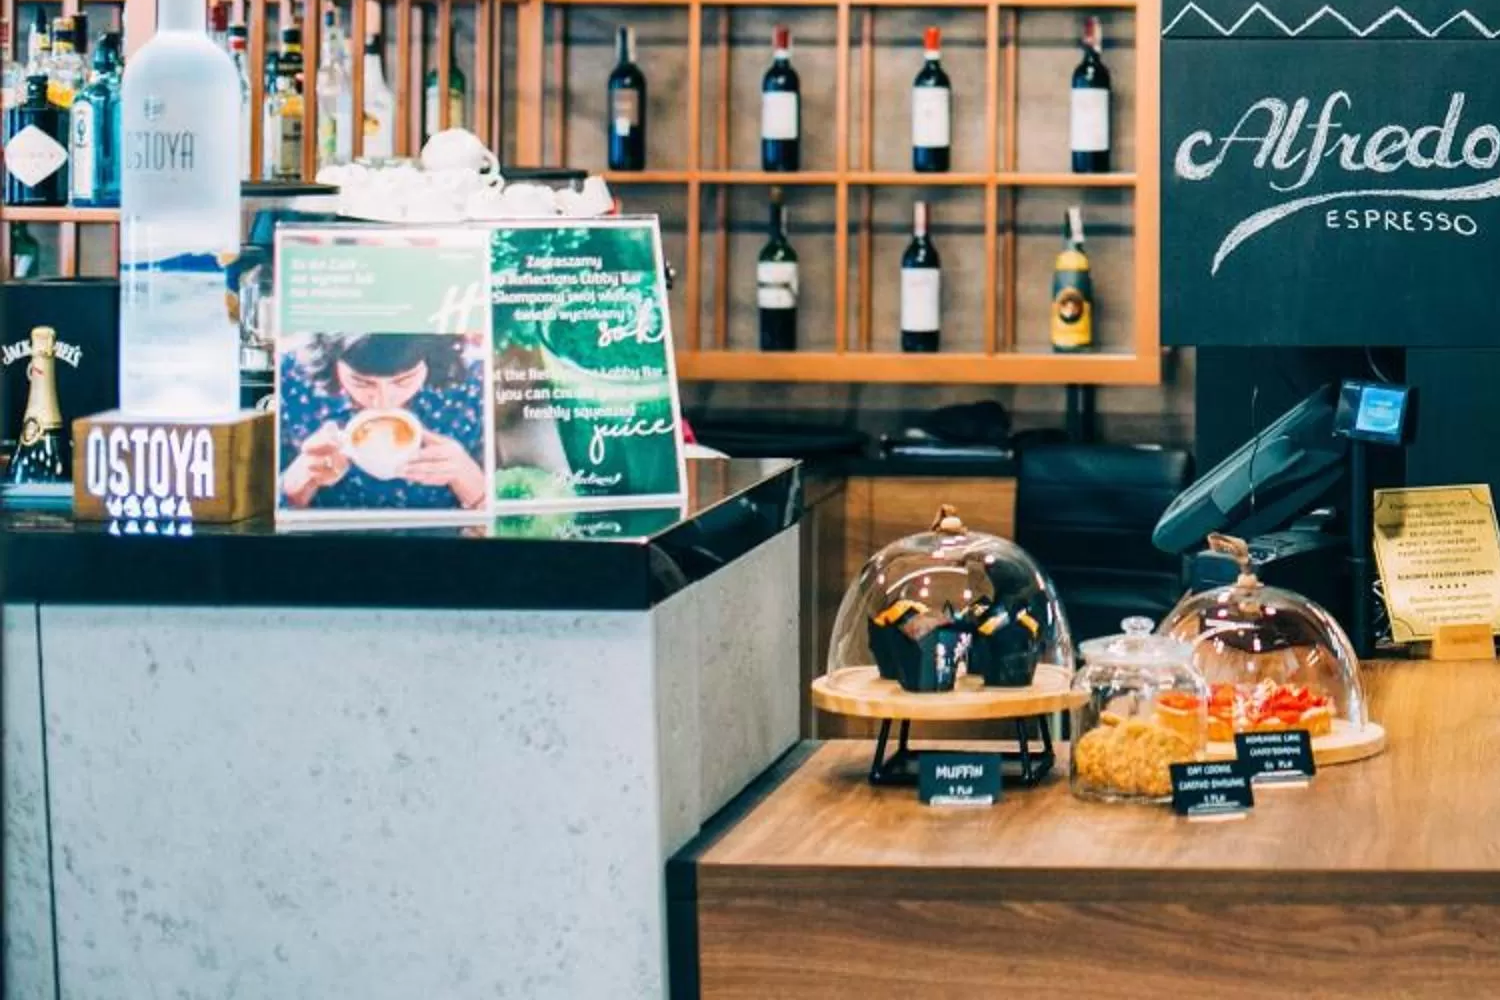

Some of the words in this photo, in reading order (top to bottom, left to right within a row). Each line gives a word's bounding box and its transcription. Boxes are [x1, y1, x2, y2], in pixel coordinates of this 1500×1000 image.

[1325, 209, 1478, 236] ESPRESSO
[589, 414, 676, 465] juice
[87, 425, 215, 498] OSTOYA
[935, 764, 984, 780] MUFFIN
